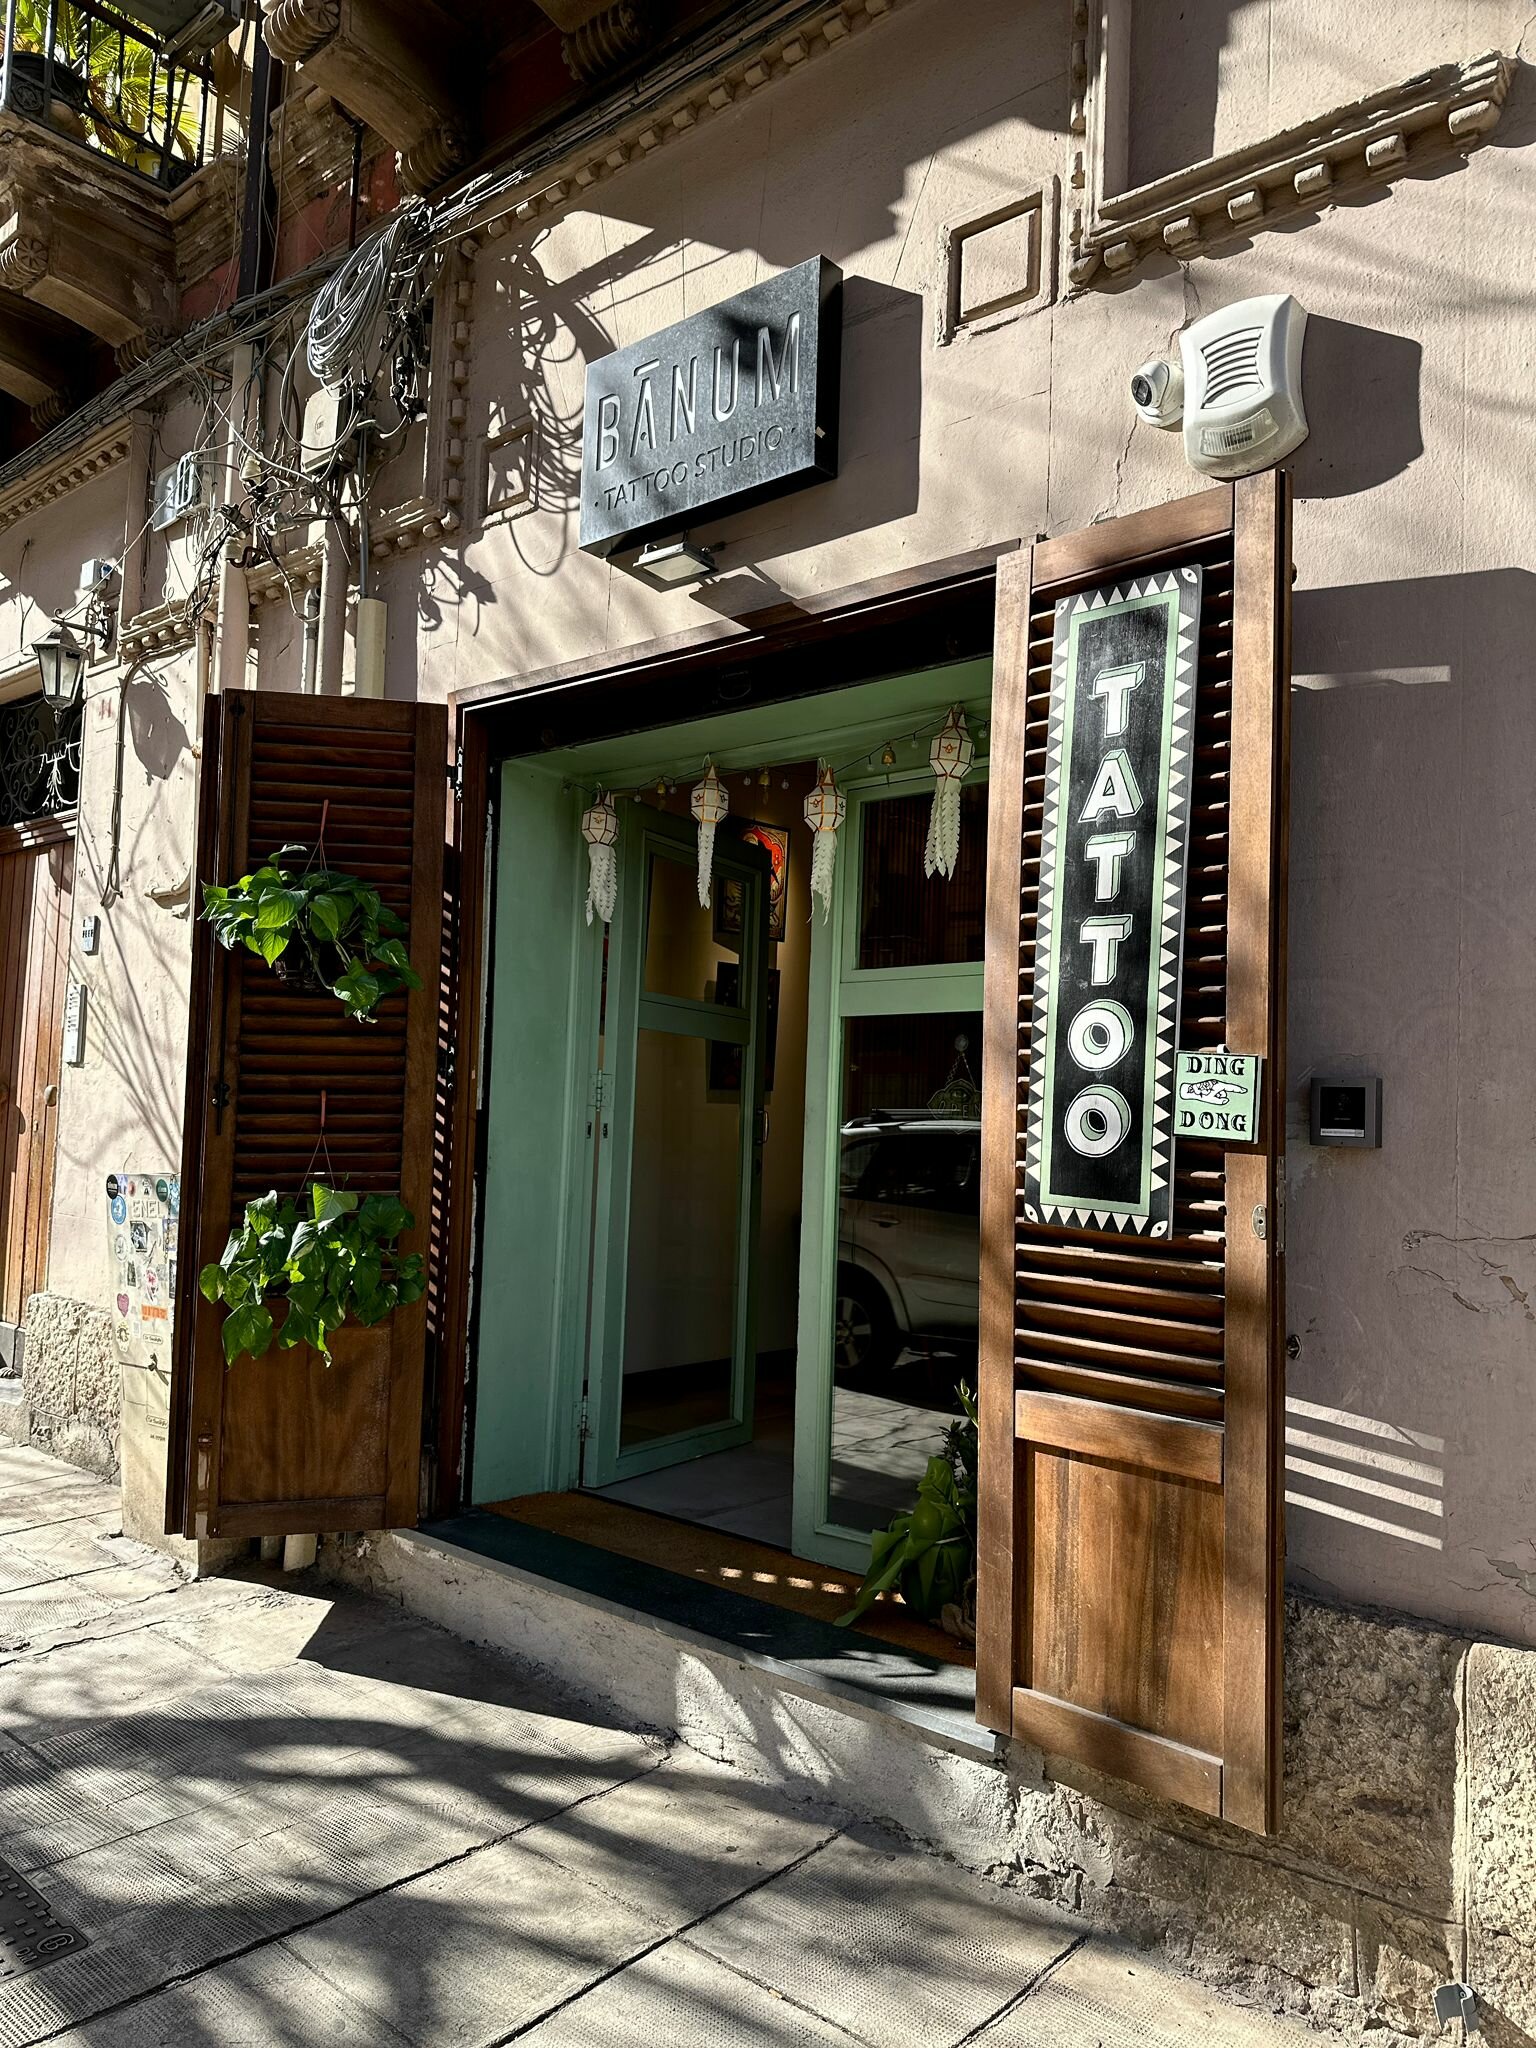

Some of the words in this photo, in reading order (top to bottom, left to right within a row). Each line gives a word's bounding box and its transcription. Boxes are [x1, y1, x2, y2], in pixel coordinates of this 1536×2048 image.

[596, 311, 800, 472] BĀNUM
[604, 461, 688, 511] TATTOO
[695, 425, 783, 478] STUDIO
[1064, 660, 1146, 1158] TATTOO
[1186, 1056, 1246, 1076] DING
[938, 1100, 980, 1118] OPEN
[1180, 1111, 1247, 1132] DONG
[133, 1200, 163, 1218] ENEL
